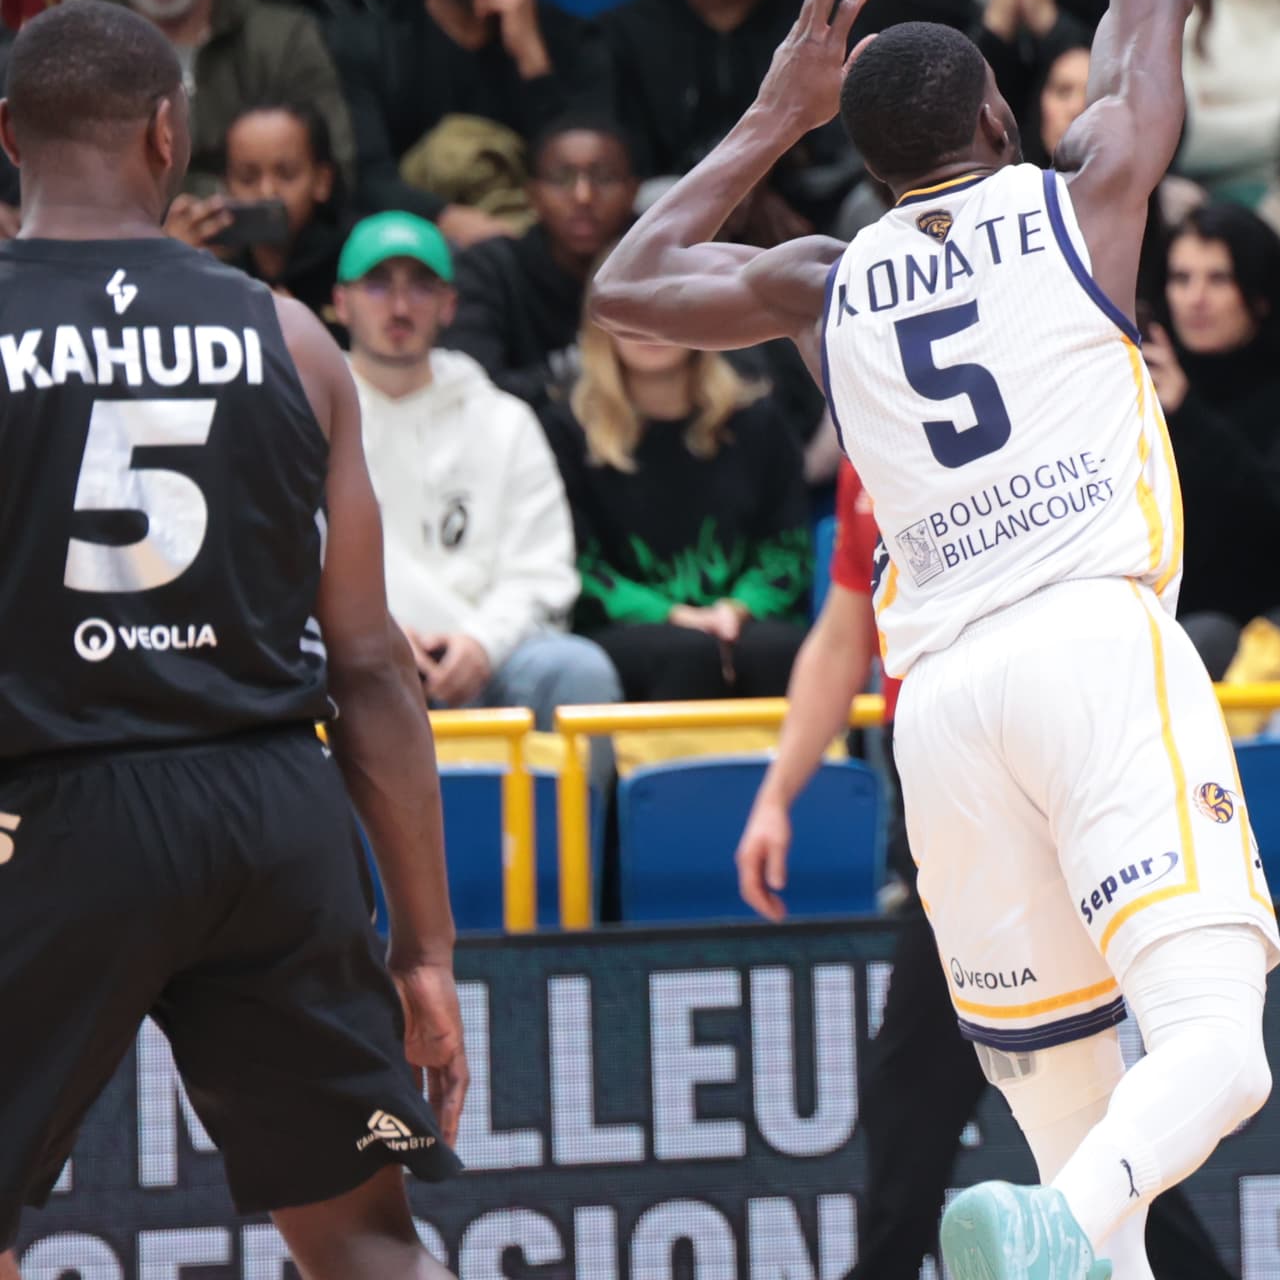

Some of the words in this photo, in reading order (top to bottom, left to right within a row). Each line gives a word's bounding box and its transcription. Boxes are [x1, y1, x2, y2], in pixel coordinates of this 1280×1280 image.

[836, 210, 1046, 326] KONATE
[0, 325, 263, 392] KAHUDI
[893, 298, 1012, 469] 5
[64, 398, 217, 593] 5
[941, 477, 1114, 568] BILLANCOURT
[118, 624, 218, 650] VEOLIA
[966, 967, 1038, 989] VEOLIA
